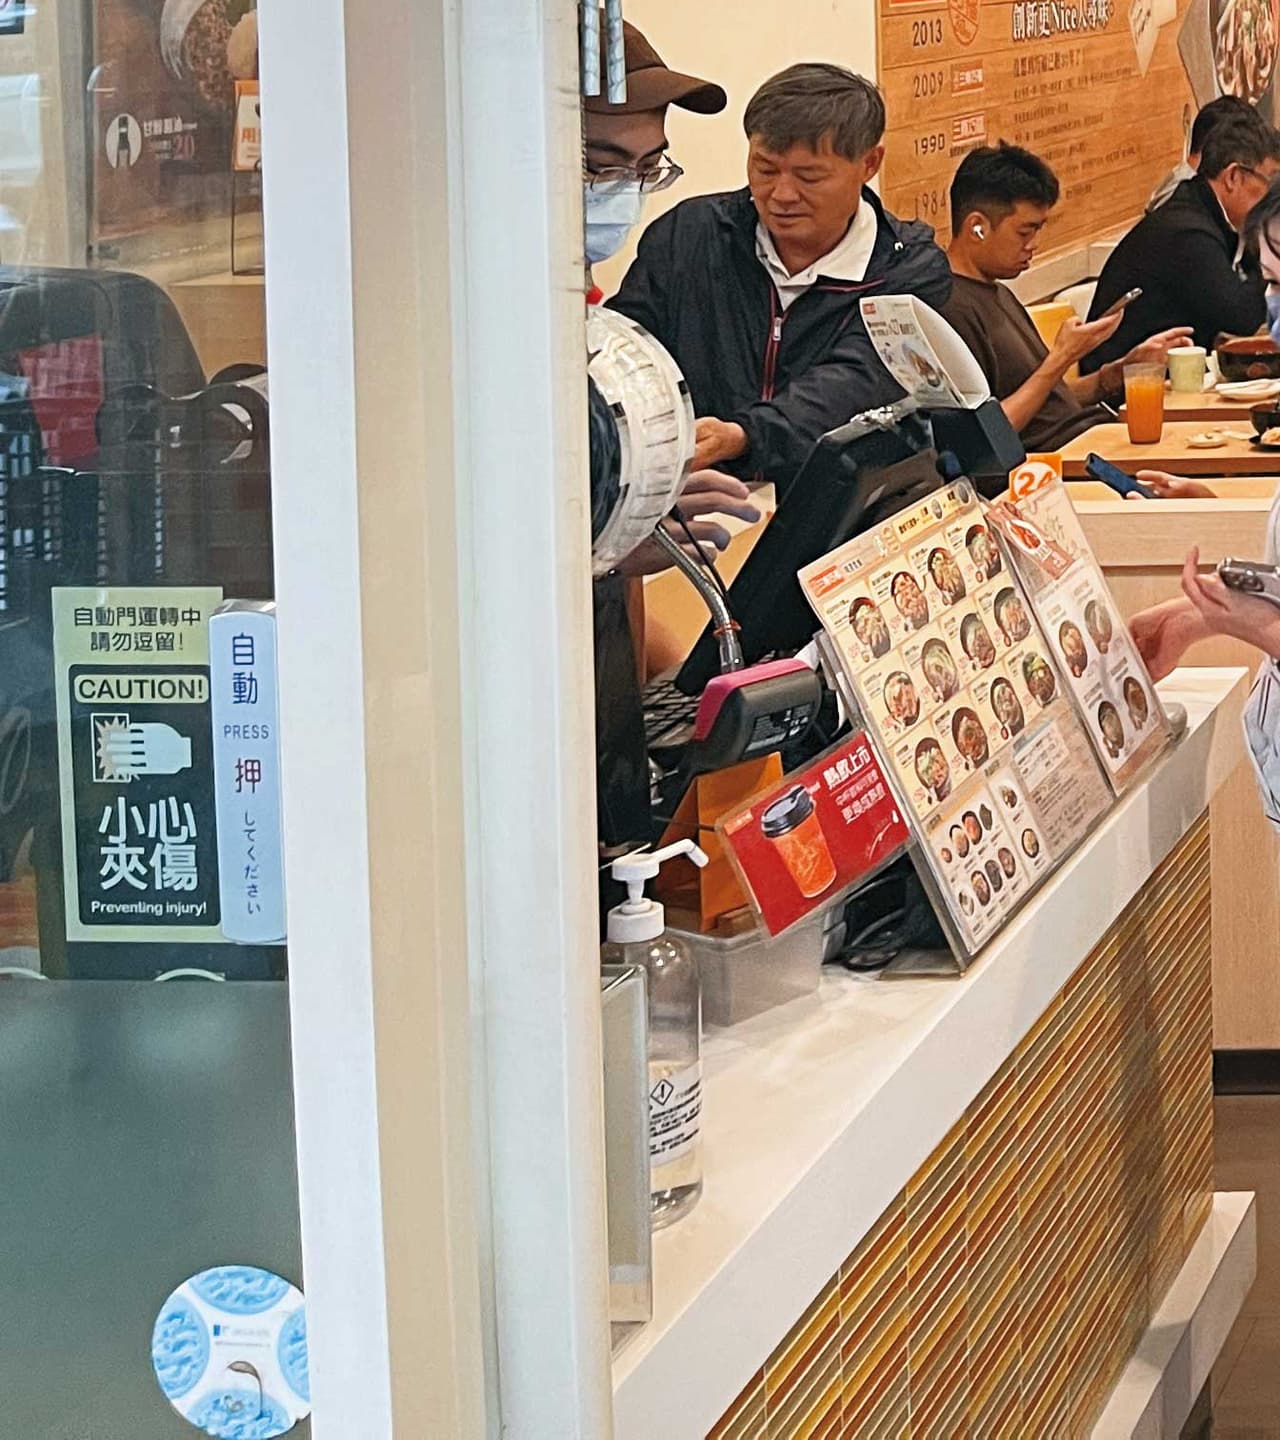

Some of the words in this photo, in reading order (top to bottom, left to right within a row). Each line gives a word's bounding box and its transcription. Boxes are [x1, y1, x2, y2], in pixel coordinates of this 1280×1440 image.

[912, 19, 942, 47] 2013
[914, 72, 943, 98] 2009
[914, 134, 945, 155] 1990
[73, 607, 201, 628] 自動門運轉中
[231, 632, 258, 705] 自動
[78, 678, 204, 701] CAUTION!
[223, 724, 270, 740] PRESS
[98, 796, 197, 843] 小心
[100, 842, 199, 893] 夾傷
[91, 901, 163, 917] Preventing
[165, 901, 207, 917] injury!
